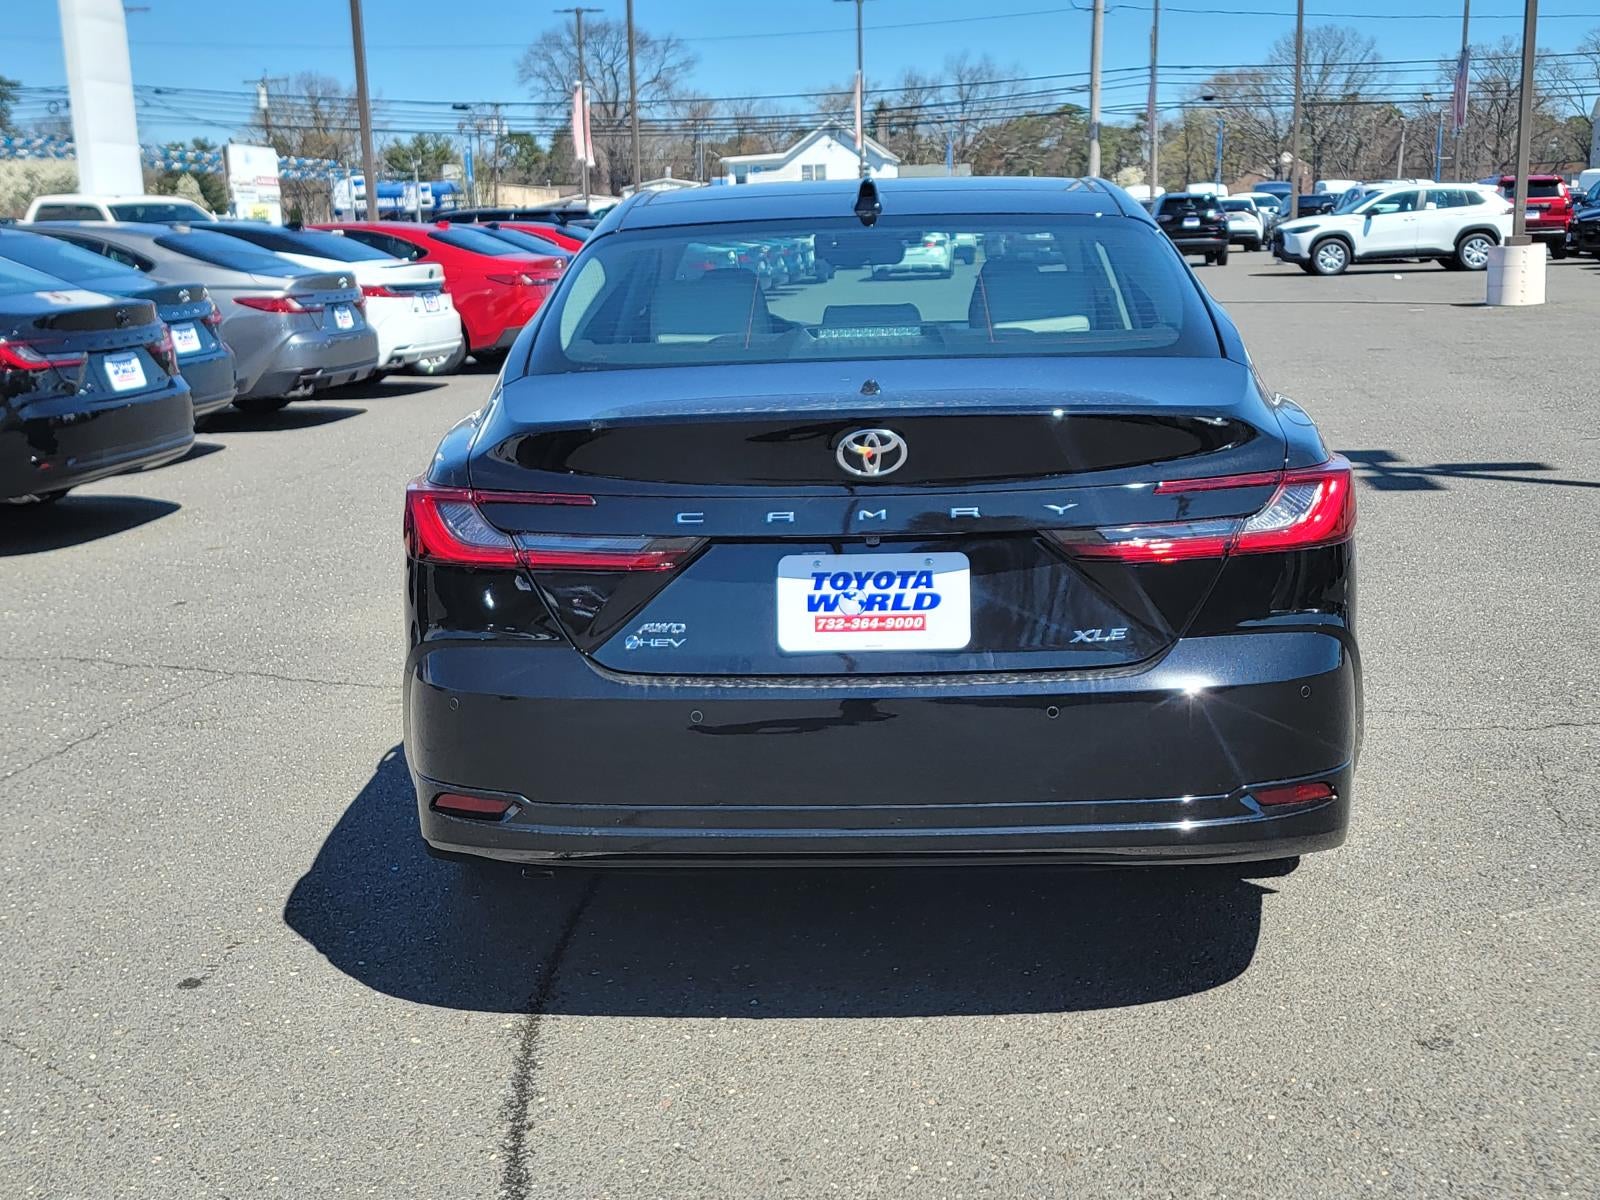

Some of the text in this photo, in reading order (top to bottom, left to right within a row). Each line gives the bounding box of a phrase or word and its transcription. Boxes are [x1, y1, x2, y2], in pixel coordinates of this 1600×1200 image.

[676, 503, 1079, 524] CAMRY
[810, 570, 934, 591] TOYOTA
[637, 622, 687, 634] AWD
[816, 616, 924, 631] 732-364-9000
[639, 638, 687, 647] HEV
[1069, 627, 1128, 643] XLE
